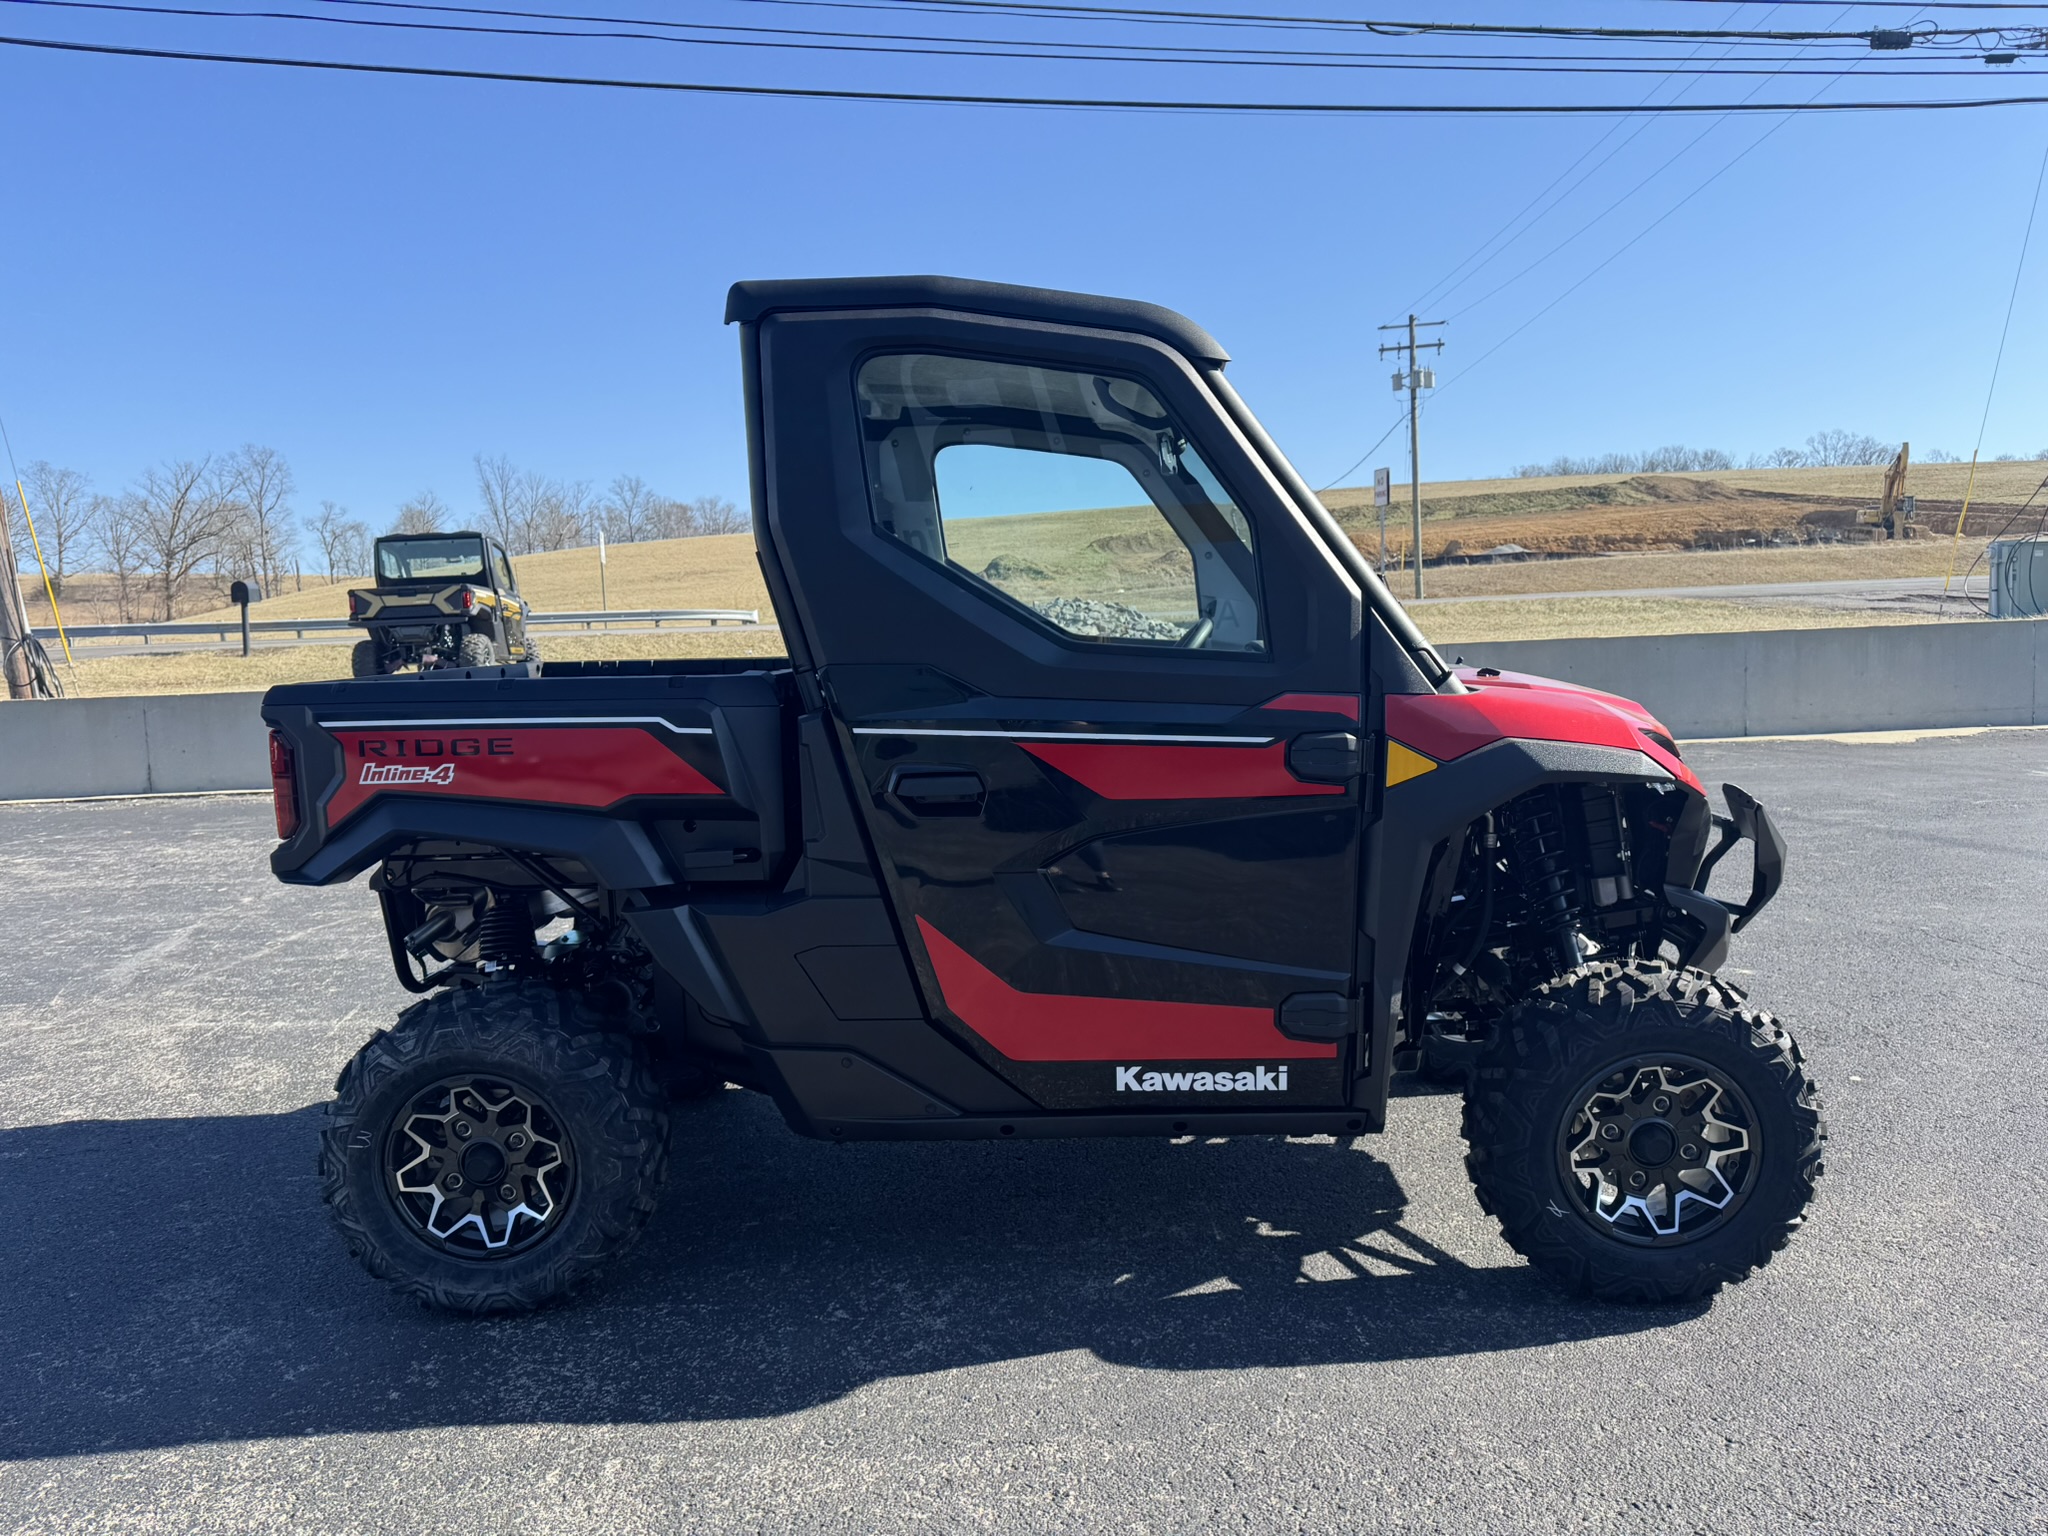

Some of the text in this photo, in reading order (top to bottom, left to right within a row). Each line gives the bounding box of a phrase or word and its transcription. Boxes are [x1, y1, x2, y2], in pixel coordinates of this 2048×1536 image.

[359, 738, 514, 757] RIDGE
[359, 763, 455, 785] Inline-4
[1116, 1065, 1288, 1092] Kawasaki
